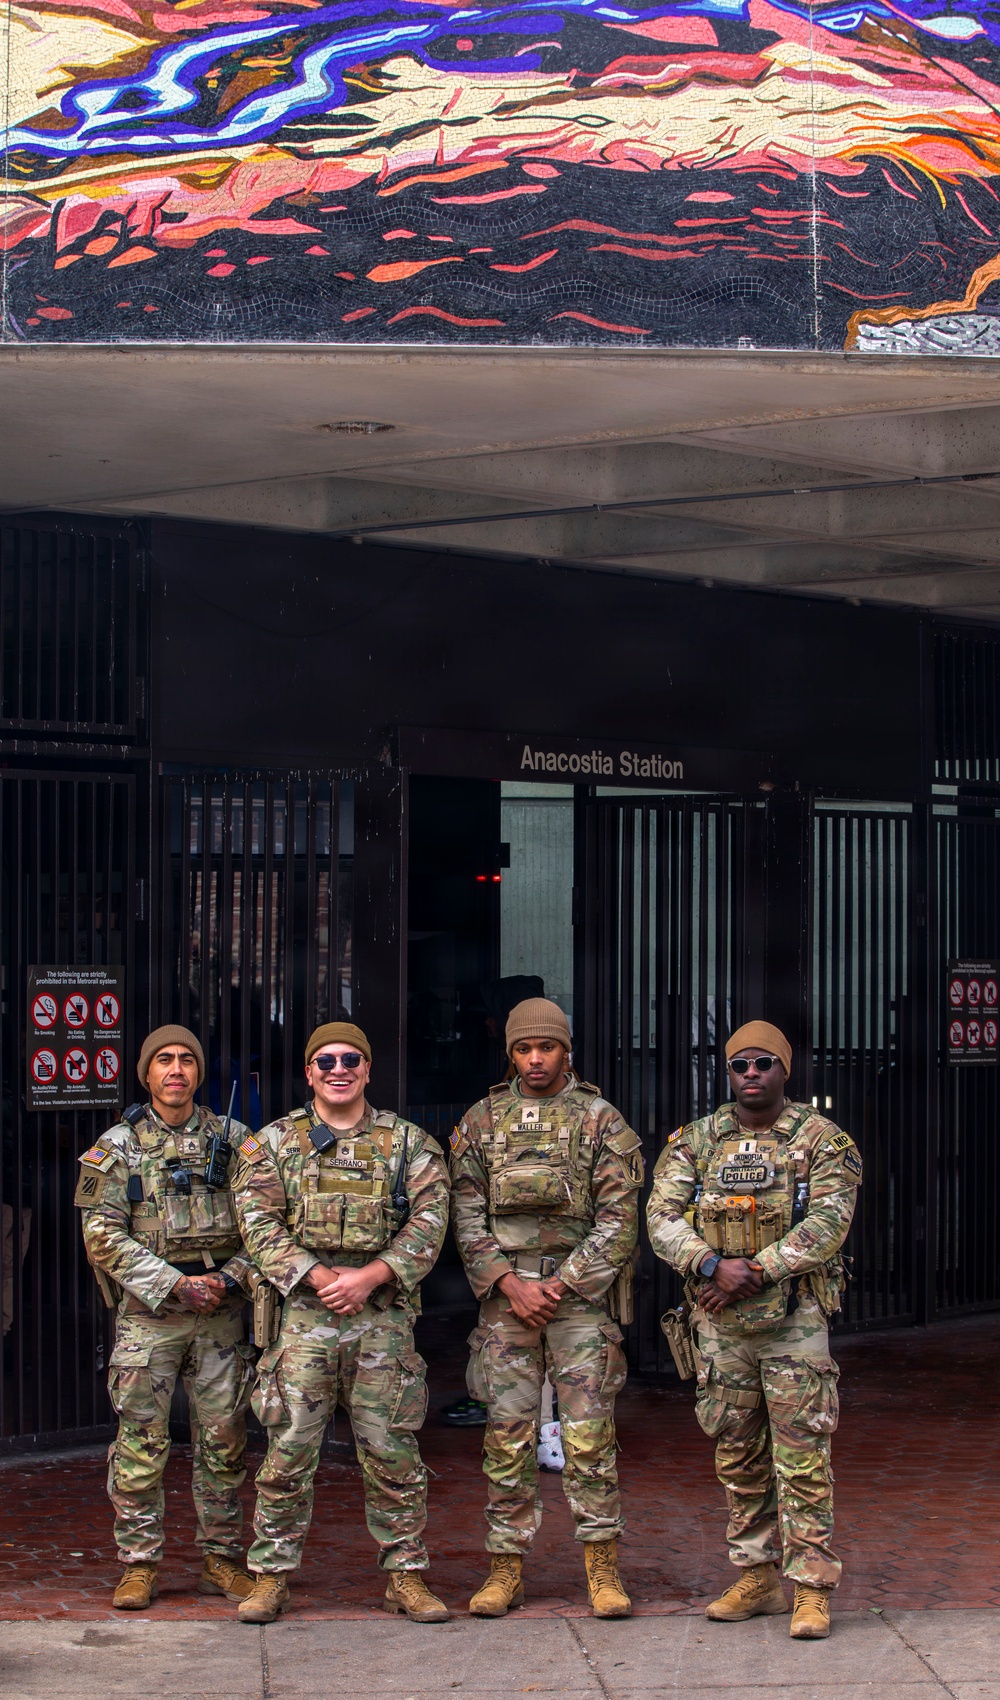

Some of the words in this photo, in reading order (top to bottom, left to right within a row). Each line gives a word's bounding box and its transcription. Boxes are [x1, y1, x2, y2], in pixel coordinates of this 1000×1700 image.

[520, 745, 613, 774] Anacostia
[619, 751, 684, 779] Station
[833, 1136, 848, 1148] MP
[330, 1158, 363, 1168] SERRANO
